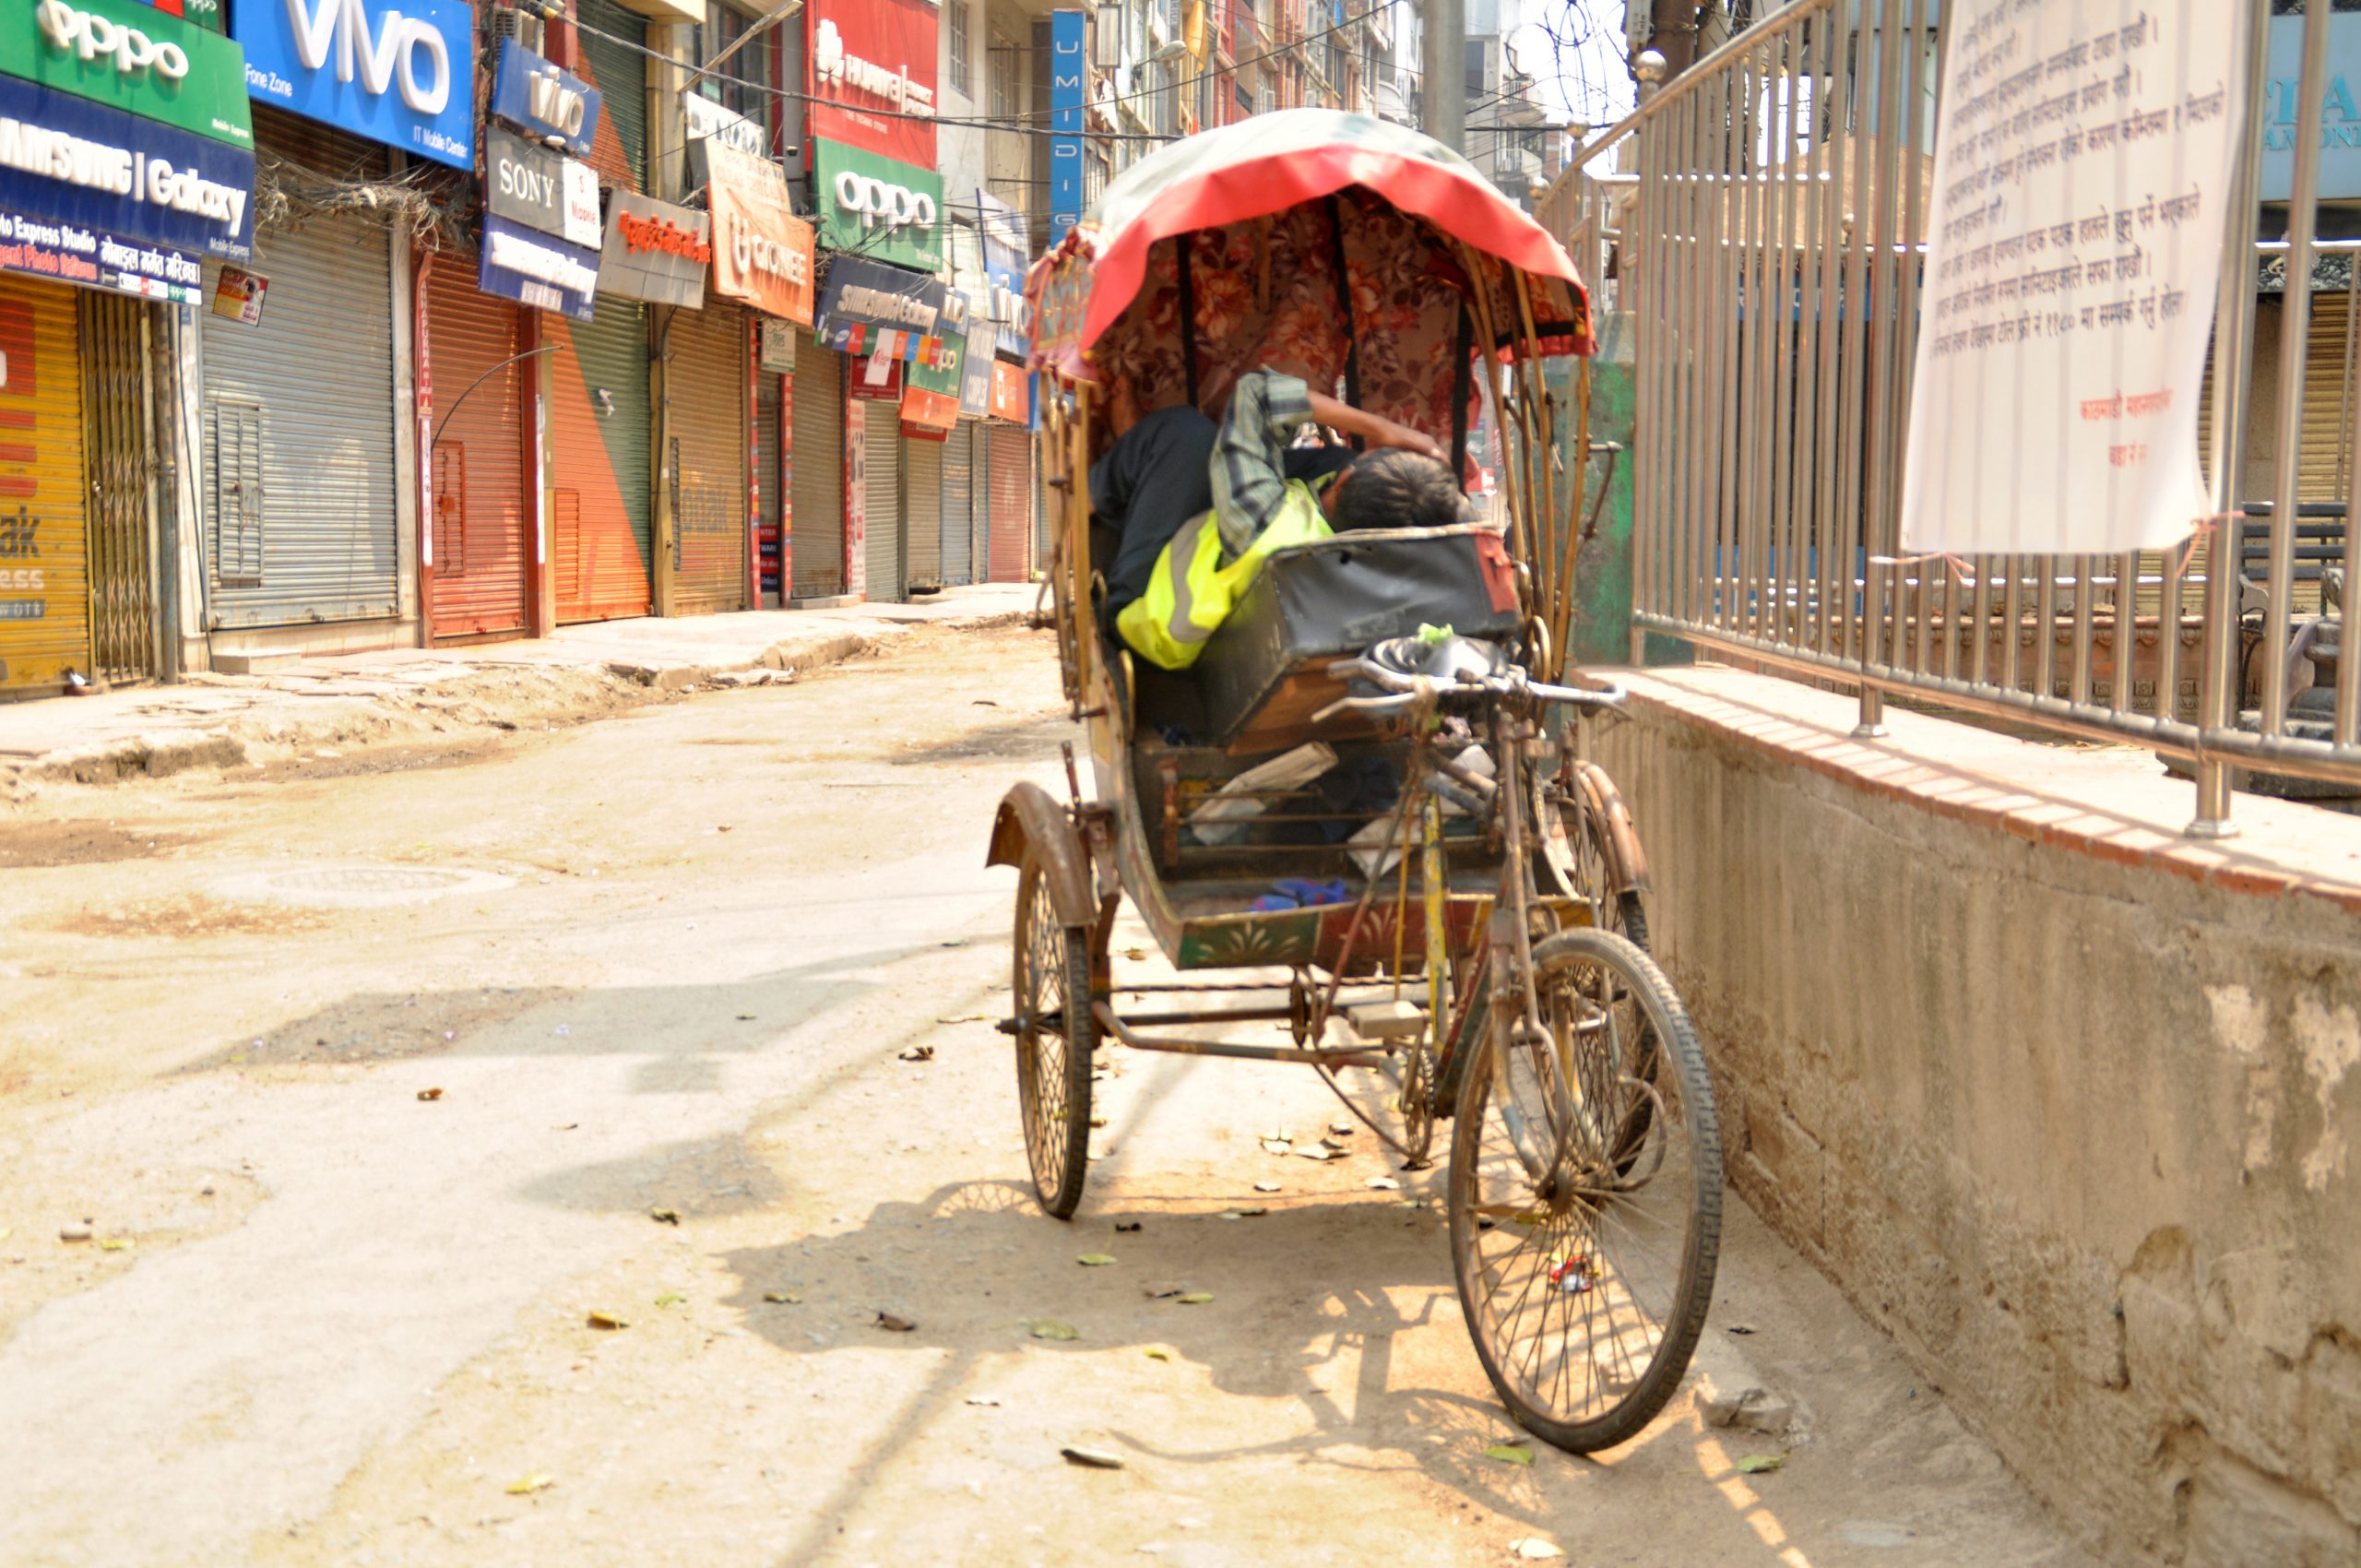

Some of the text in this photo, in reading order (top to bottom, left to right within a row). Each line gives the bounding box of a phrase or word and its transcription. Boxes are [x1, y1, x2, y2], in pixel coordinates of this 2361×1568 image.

[38, 0, 188, 77] oppo
[245, 63, 292, 98] Fone Zone
[413, 125, 469, 159] IT Mobile Center
[0, 117, 247, 237] AMSUNG Galaxy
[499, 158, 555, 208] SONY
[836, 171, 937, 232] oppo
[14, 215, 60, 245] Express
[61, 225, 97, 254] Studio
[210, 237, 250, 258] Mobile Express
[0, 244, 23, 267] gent
[24, 244, 58, 273] Photo
